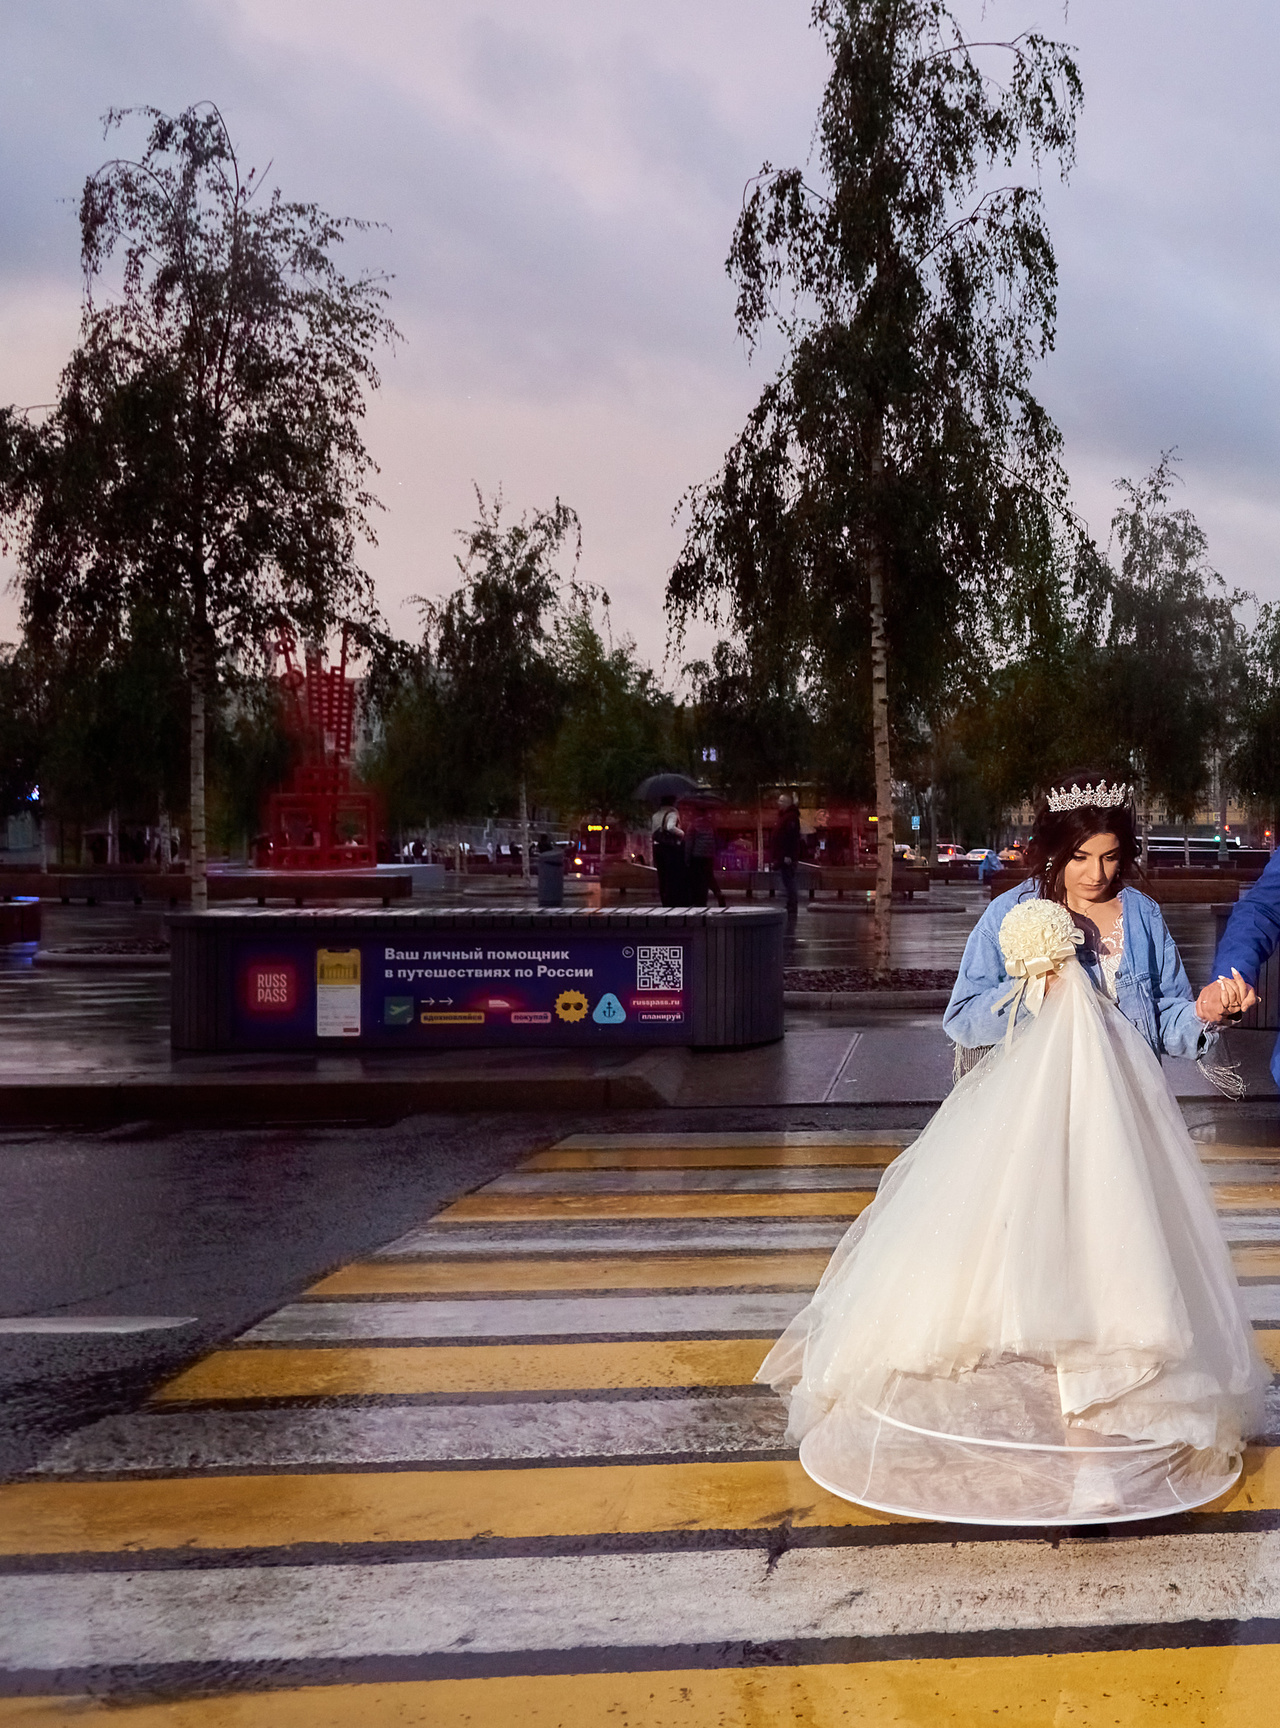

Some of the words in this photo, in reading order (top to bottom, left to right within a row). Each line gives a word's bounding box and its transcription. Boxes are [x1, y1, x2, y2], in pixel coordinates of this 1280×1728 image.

[384, 948, 419, 960] Ваш
[423, 947, 483, 960] личный
[487, 951, 570, 962] помощник
[384, 969, 393, 978] в
[397, 969, 511, 982] путешествиях
[514, 969, 533, 977] по
[537, 965, 593, 977] России
[258, 974, 287, 988] RUSS
[258, 988, 287, 1002] PASS
[513, 1013, 549, 1022] покупай
[641, 1013, 681, 1021] планируй
